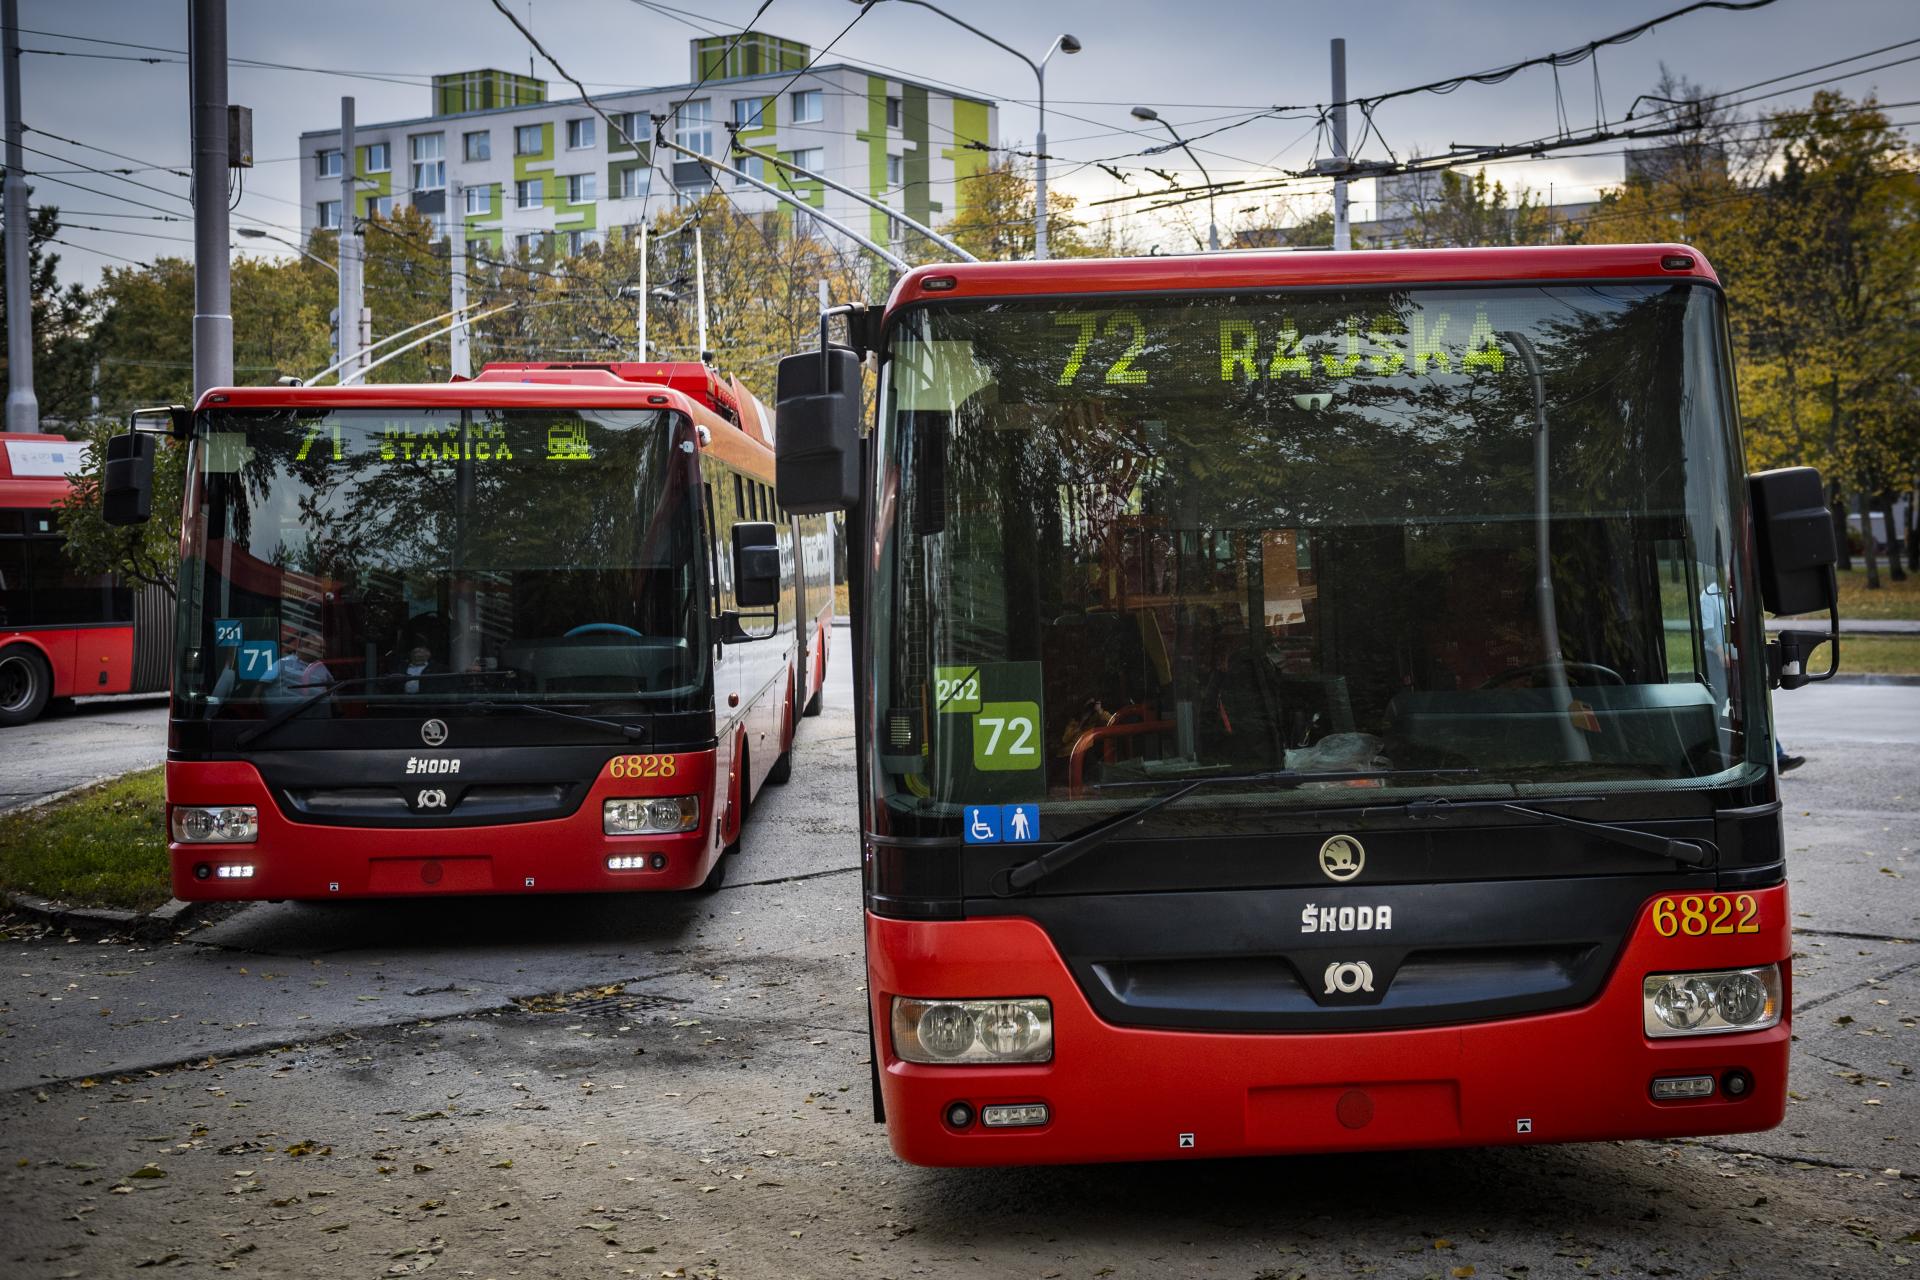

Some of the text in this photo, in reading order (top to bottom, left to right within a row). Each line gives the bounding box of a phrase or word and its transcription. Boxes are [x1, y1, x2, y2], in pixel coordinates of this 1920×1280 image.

[1054, 311, 1148, 386] 72
[296, 418, 342, 460] 71
[381, 442, 513, 460] STANICA
[243, 648, 274, 672] 71
[937, 678, 979, 701] 202
[979, 717, 1035, 756] 72
[405, 756, 461, 774] ŠKODA
[609, 754, 677, 778] 6828
[1301, 903, 1393, 933] ŠKODA
[1652, 894, 1760, 938] 6822
